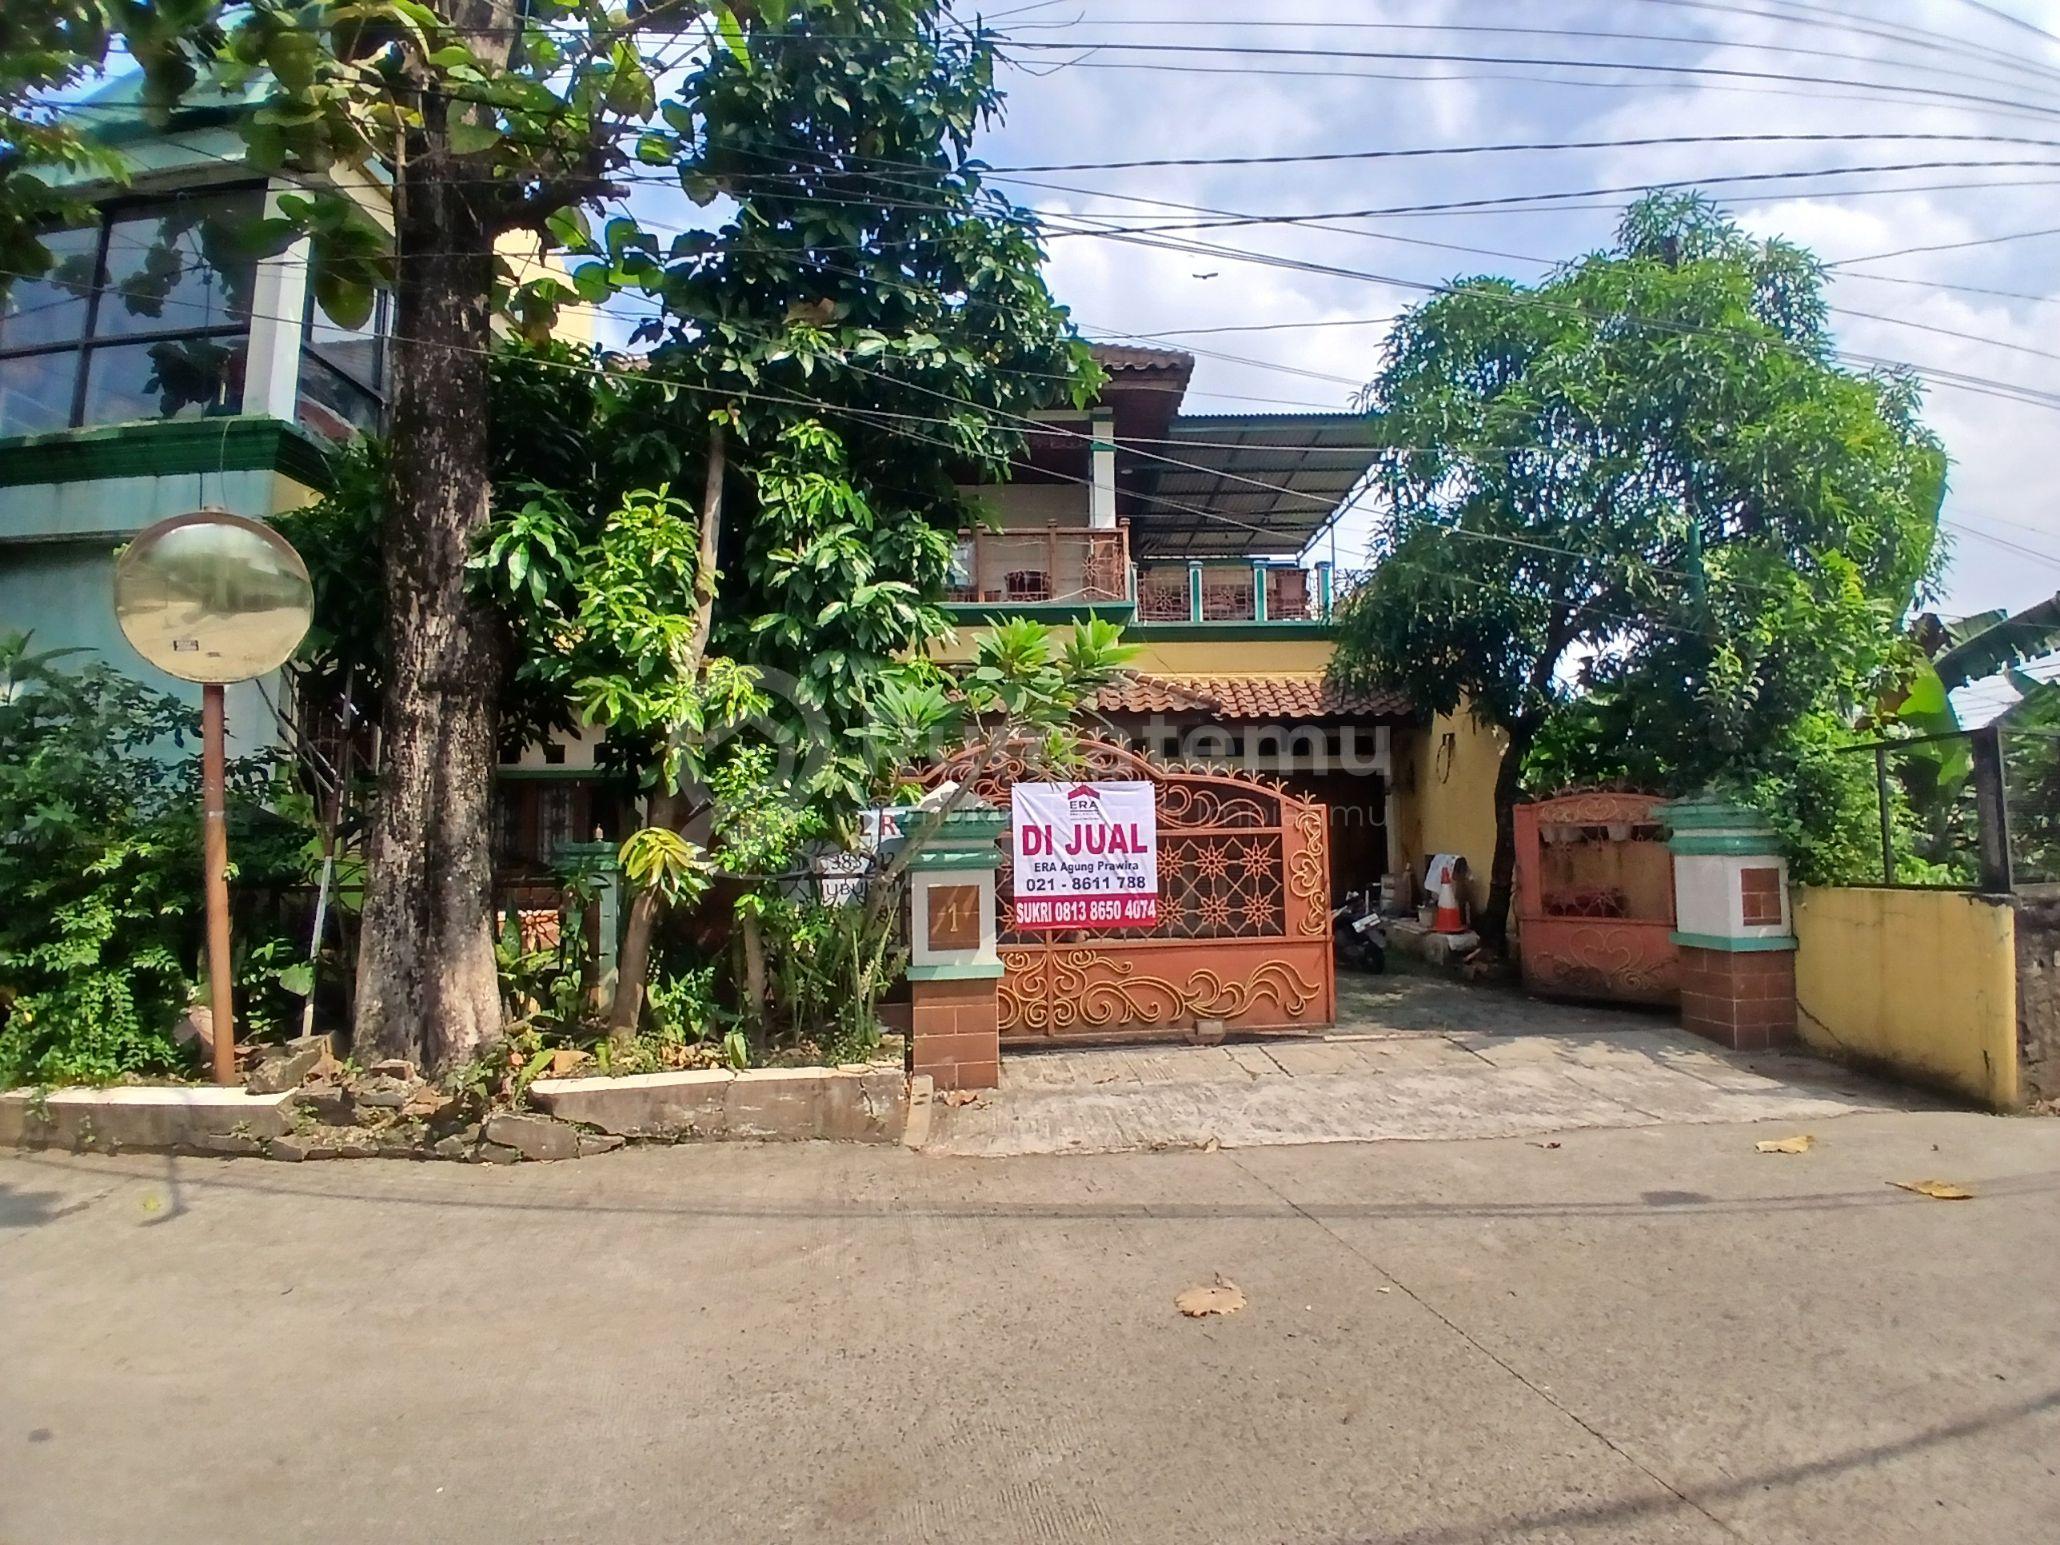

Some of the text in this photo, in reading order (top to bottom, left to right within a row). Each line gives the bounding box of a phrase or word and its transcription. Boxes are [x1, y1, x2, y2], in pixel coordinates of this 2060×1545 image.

[1069, 800, 1098, 809] ERA
[1022, 823, 1148, 856] DI JUAL
[1034, 861, 1139, 874] ERA Agung Prawira
[1026, 878, 1055, 892] 021
[1072, 877, 1110, 890] 8611
[1116, 876, 1146, 889] 788
[1016, 899, 1156, 924] SUKRI 0813 8650 4074
